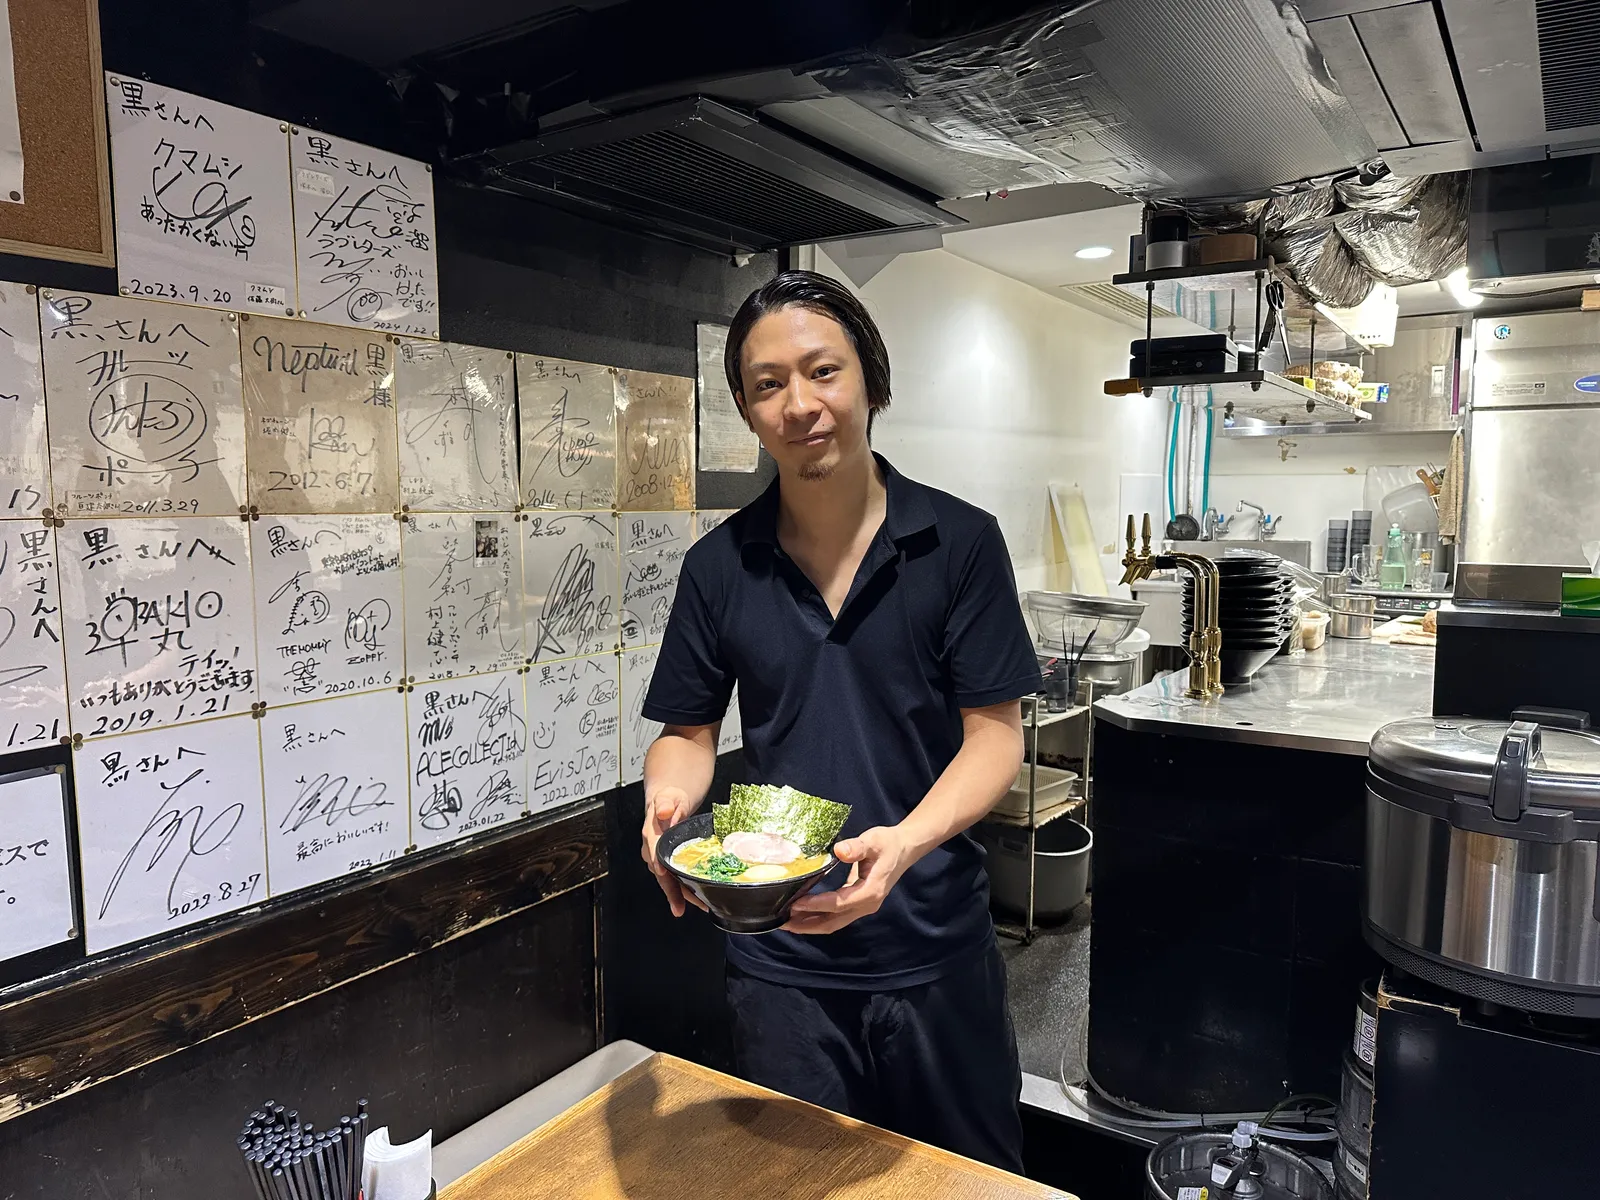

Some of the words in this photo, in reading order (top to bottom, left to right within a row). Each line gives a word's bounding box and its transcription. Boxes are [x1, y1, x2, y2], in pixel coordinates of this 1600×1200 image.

[119, 81, 214, 132] 黒さんへ
[153, 137, 243, 180] クマムシ
[306, 136, 408, 189] 黒さんへ
[50, 296, 210, 347] 黒さんへ
[81, 526, 236, 570] 黒さんへ
[630, 519, 674, 548] 黒さんへ
[17, 529, 61, 644] 黒さんへ
[423, 690, 494, 719] 黒さんへ
[282, 723, 346, 752] 黒さんへ
[100, 746, 207, 788] 黒さんへ
[542, 774, 602, 805] 2022.08.17
